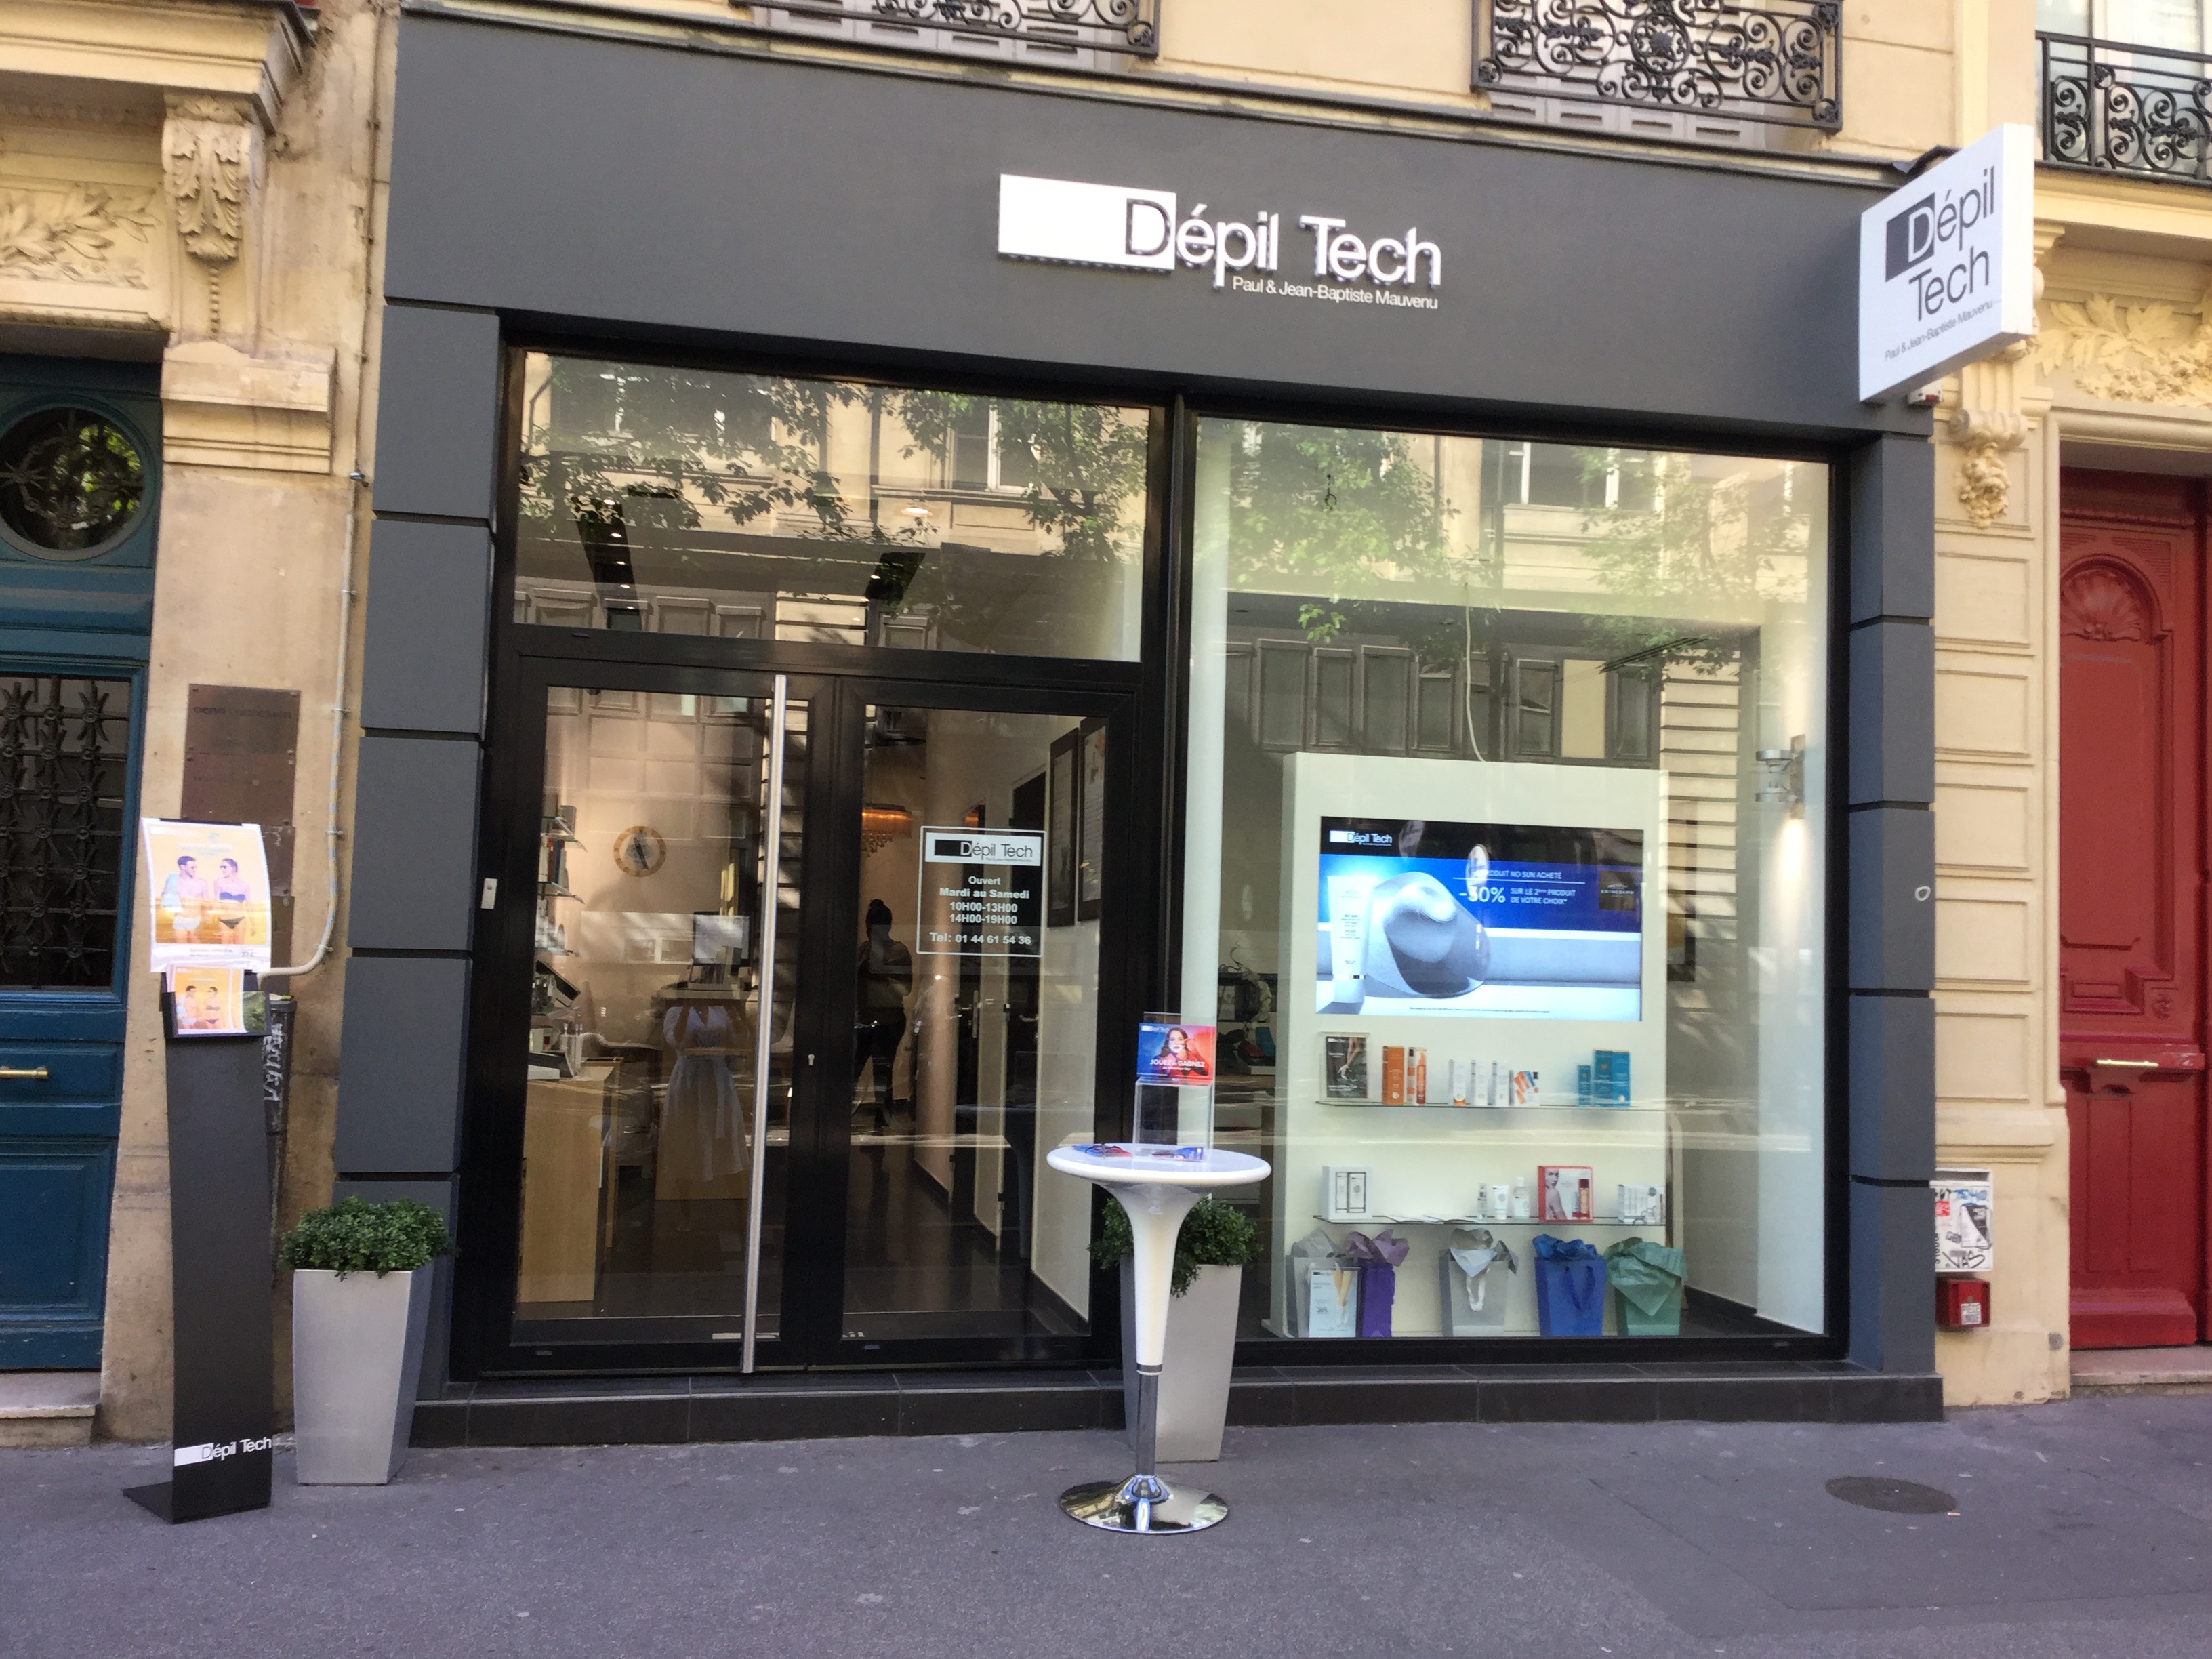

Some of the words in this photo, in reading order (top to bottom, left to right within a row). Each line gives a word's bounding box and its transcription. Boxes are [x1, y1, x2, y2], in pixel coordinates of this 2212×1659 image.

[1907, 165, 1995, 264] Dépil
[1125, 197, 1279, 287] Dépil
[1299, 214, 1442, 287] Tech
[1908, 245, 1990, 322] Tech
[1232, 276, 1263, 293] Paul
[1266, 280, 1277, 294] &
[1279, 281, 1374, 303] Jean-Baptiste
[1375, 290, 1439, 309] Mauvenu
[1885, 345, 1900, 361] Paul
[1347, 832, 1370, 845] Dépil
[1370, 833, 1393, 844] Tech
[960, 842, 996, 861] Dépil
[1000, 843, 1033, 858] Tech
[968, 876, 1002, 886] Ouvert
[939, 888, 971, 897] Mardi
[972, 890, 987, 898] au
[989, 890, 1030, 899] Samedi
[1547, 888, 1576, 897] PRODUIT
[949, 901, 1019, 913] 10H00-13H00
[1510, 896, 1520, 904] DE
[1520, 897, 1542, 905] VOTRE
[949, 913, 1018, 924] 14H00-19H00
[929, 932, 952, 943] Tel:
[955, 934, 968, 943] 01
[970, 935, 985, 943] 44
[986, 935, 1000, 944] 61
[1002, 935, 1016, 945] 54
[1018, 936, 1032, 945] 36
[201, 1441, 237, 1461] Dépil
[239, 1436, 272, 1454] Tech
